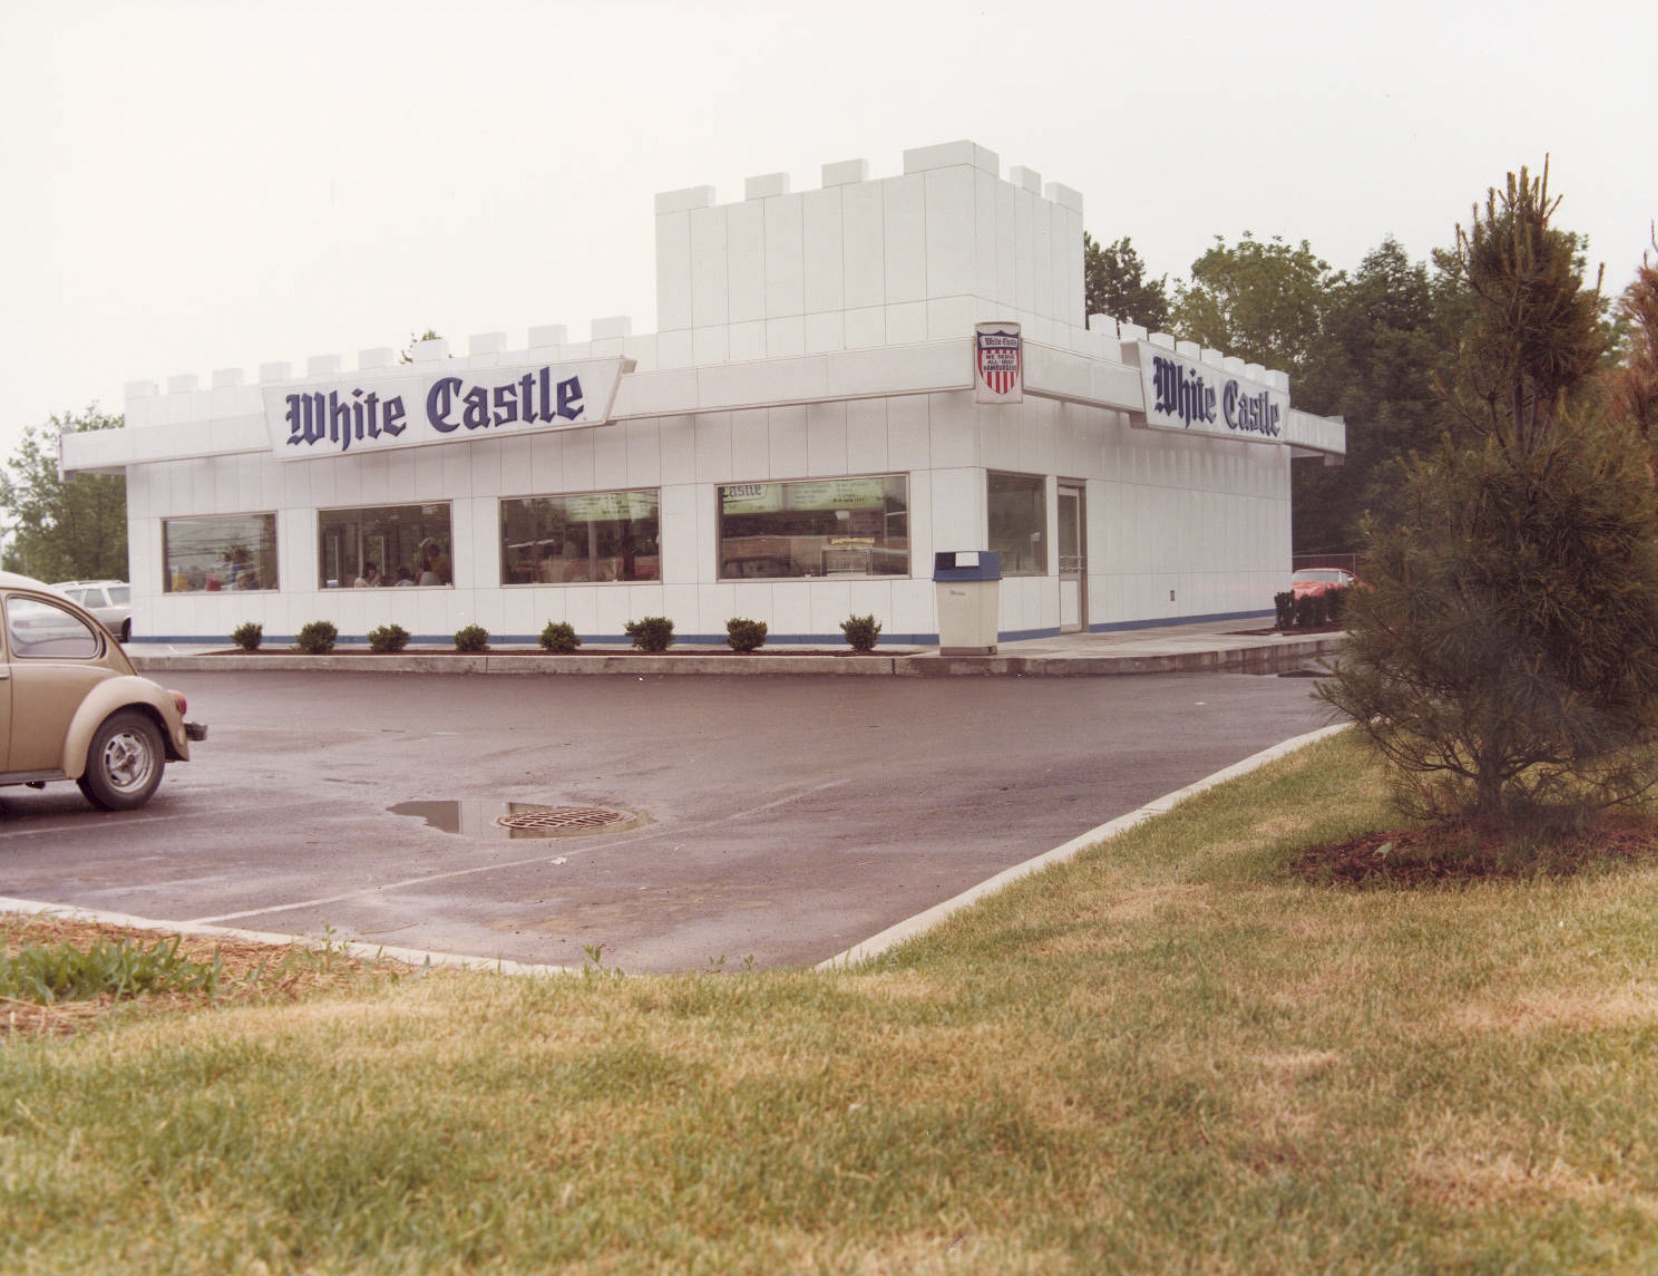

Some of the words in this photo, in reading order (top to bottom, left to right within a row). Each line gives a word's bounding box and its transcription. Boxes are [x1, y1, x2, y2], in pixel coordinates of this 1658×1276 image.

[285, 387, 407, 451] White
[426, 366, 584, 434] Castle
[1153, 356, 1216, 429] White
[1222, 379, 1281, 437] Castle
